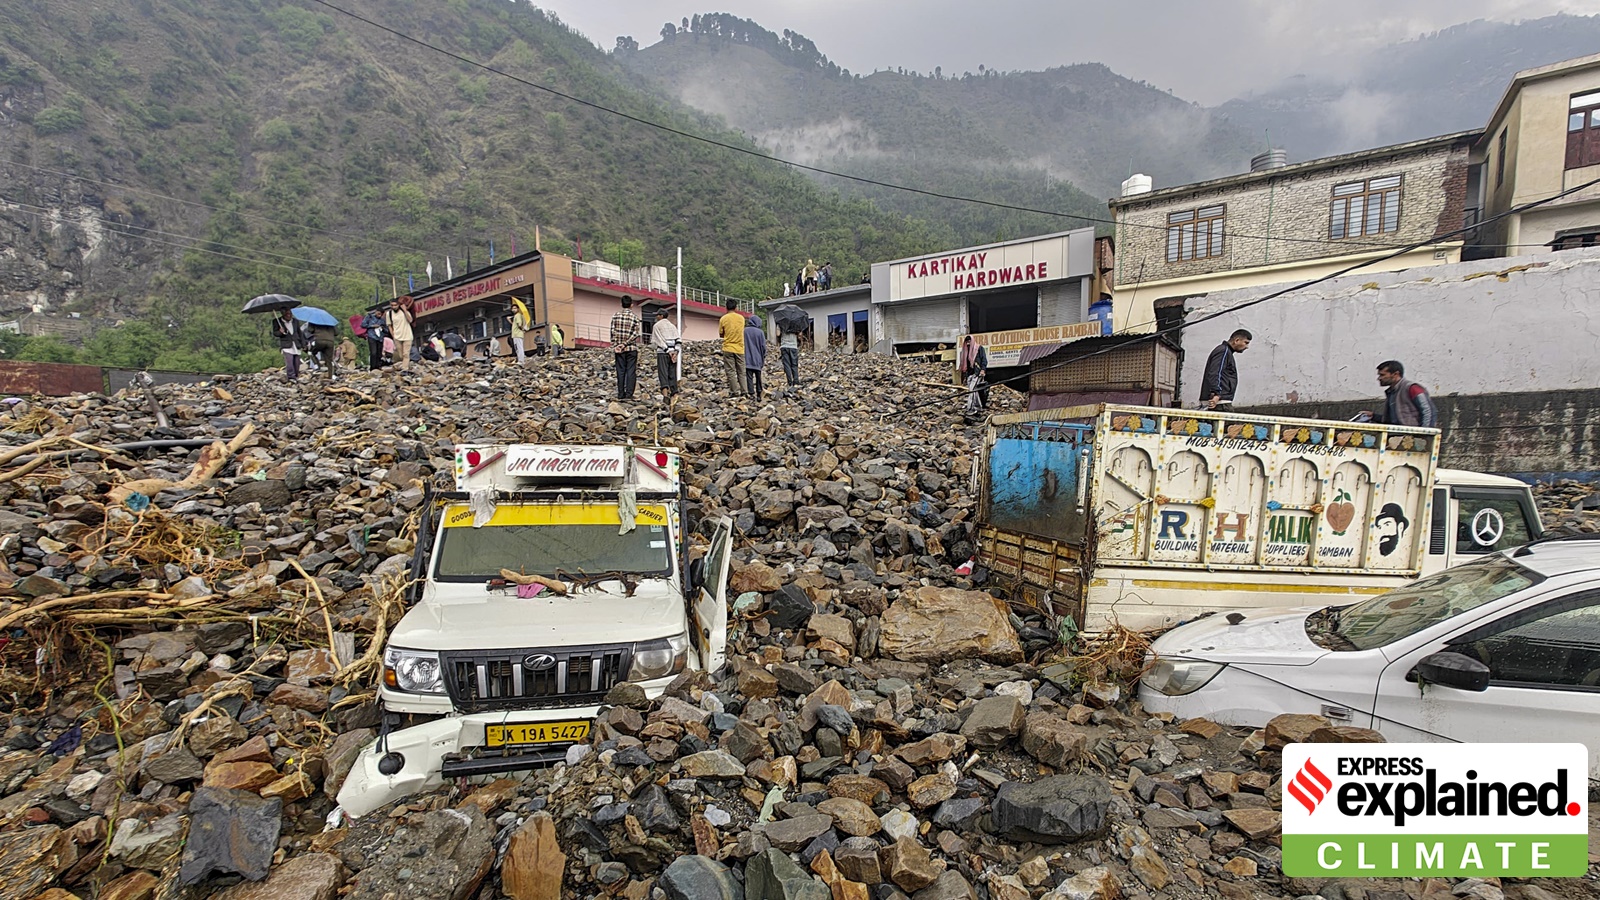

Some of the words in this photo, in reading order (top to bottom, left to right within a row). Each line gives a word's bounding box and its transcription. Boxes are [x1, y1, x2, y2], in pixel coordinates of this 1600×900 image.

[908, 252, 987, 279] KARTIKAY
[954, 262, 1047, 290] HARDWARE
[453, 277, 501, 303] RESTAURANT
[991, 330, 1031, 345] CLOTHING
[1033, 327, 1060, 341] HOUSE
[1062, 322, 1099, 339] RAMBAN
[507, 457, 535, 472] JAI
[536, 457, 586, 472] NAGNI
[585, 458, 619, 472] MATA
[451, 510, 472, 523] GOODS
[638, 507, 664, 522] CARRIER
[1154, 540, 1198, 551] BUILDING
[1211, 542, 1250, 554] MATERIAL
[497, 728, 515, 742] JK
[521, 728, 546, 741] 19A
[551, 725, 587, 739] 5427
